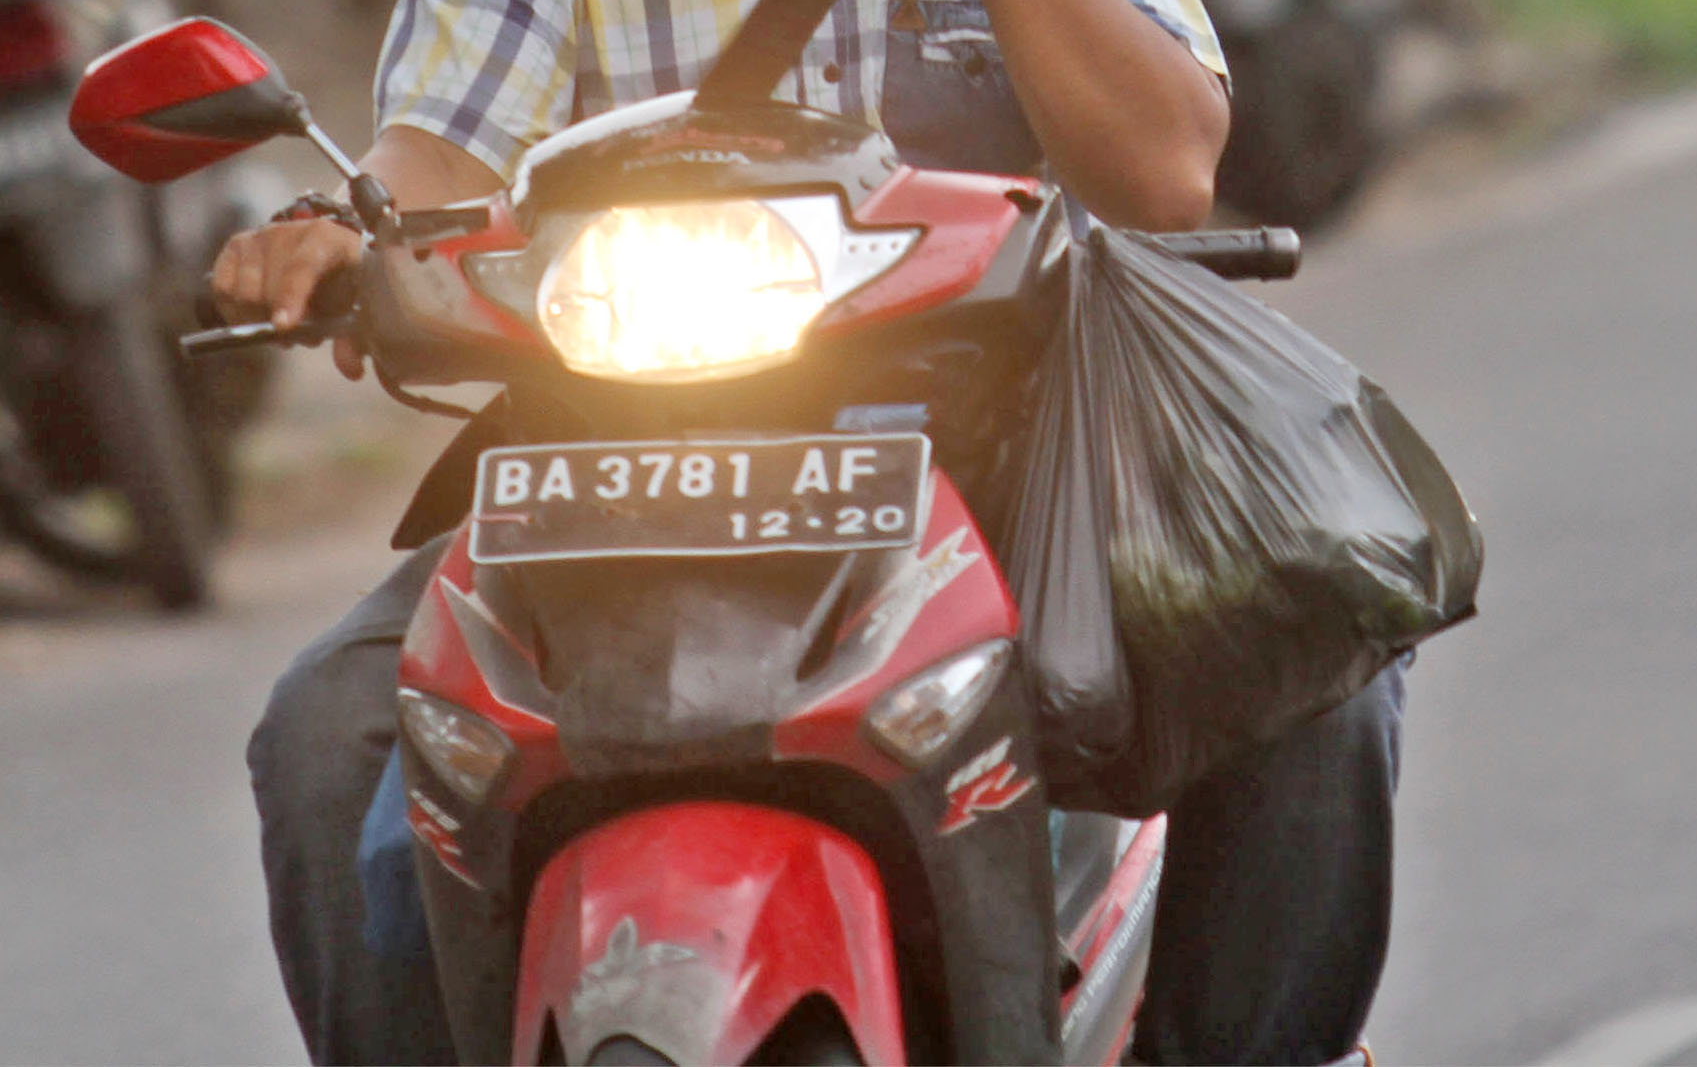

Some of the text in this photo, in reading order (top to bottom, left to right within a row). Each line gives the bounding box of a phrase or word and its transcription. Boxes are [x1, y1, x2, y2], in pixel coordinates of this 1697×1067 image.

[494, 446, 878, 506] BA 3781 AF
